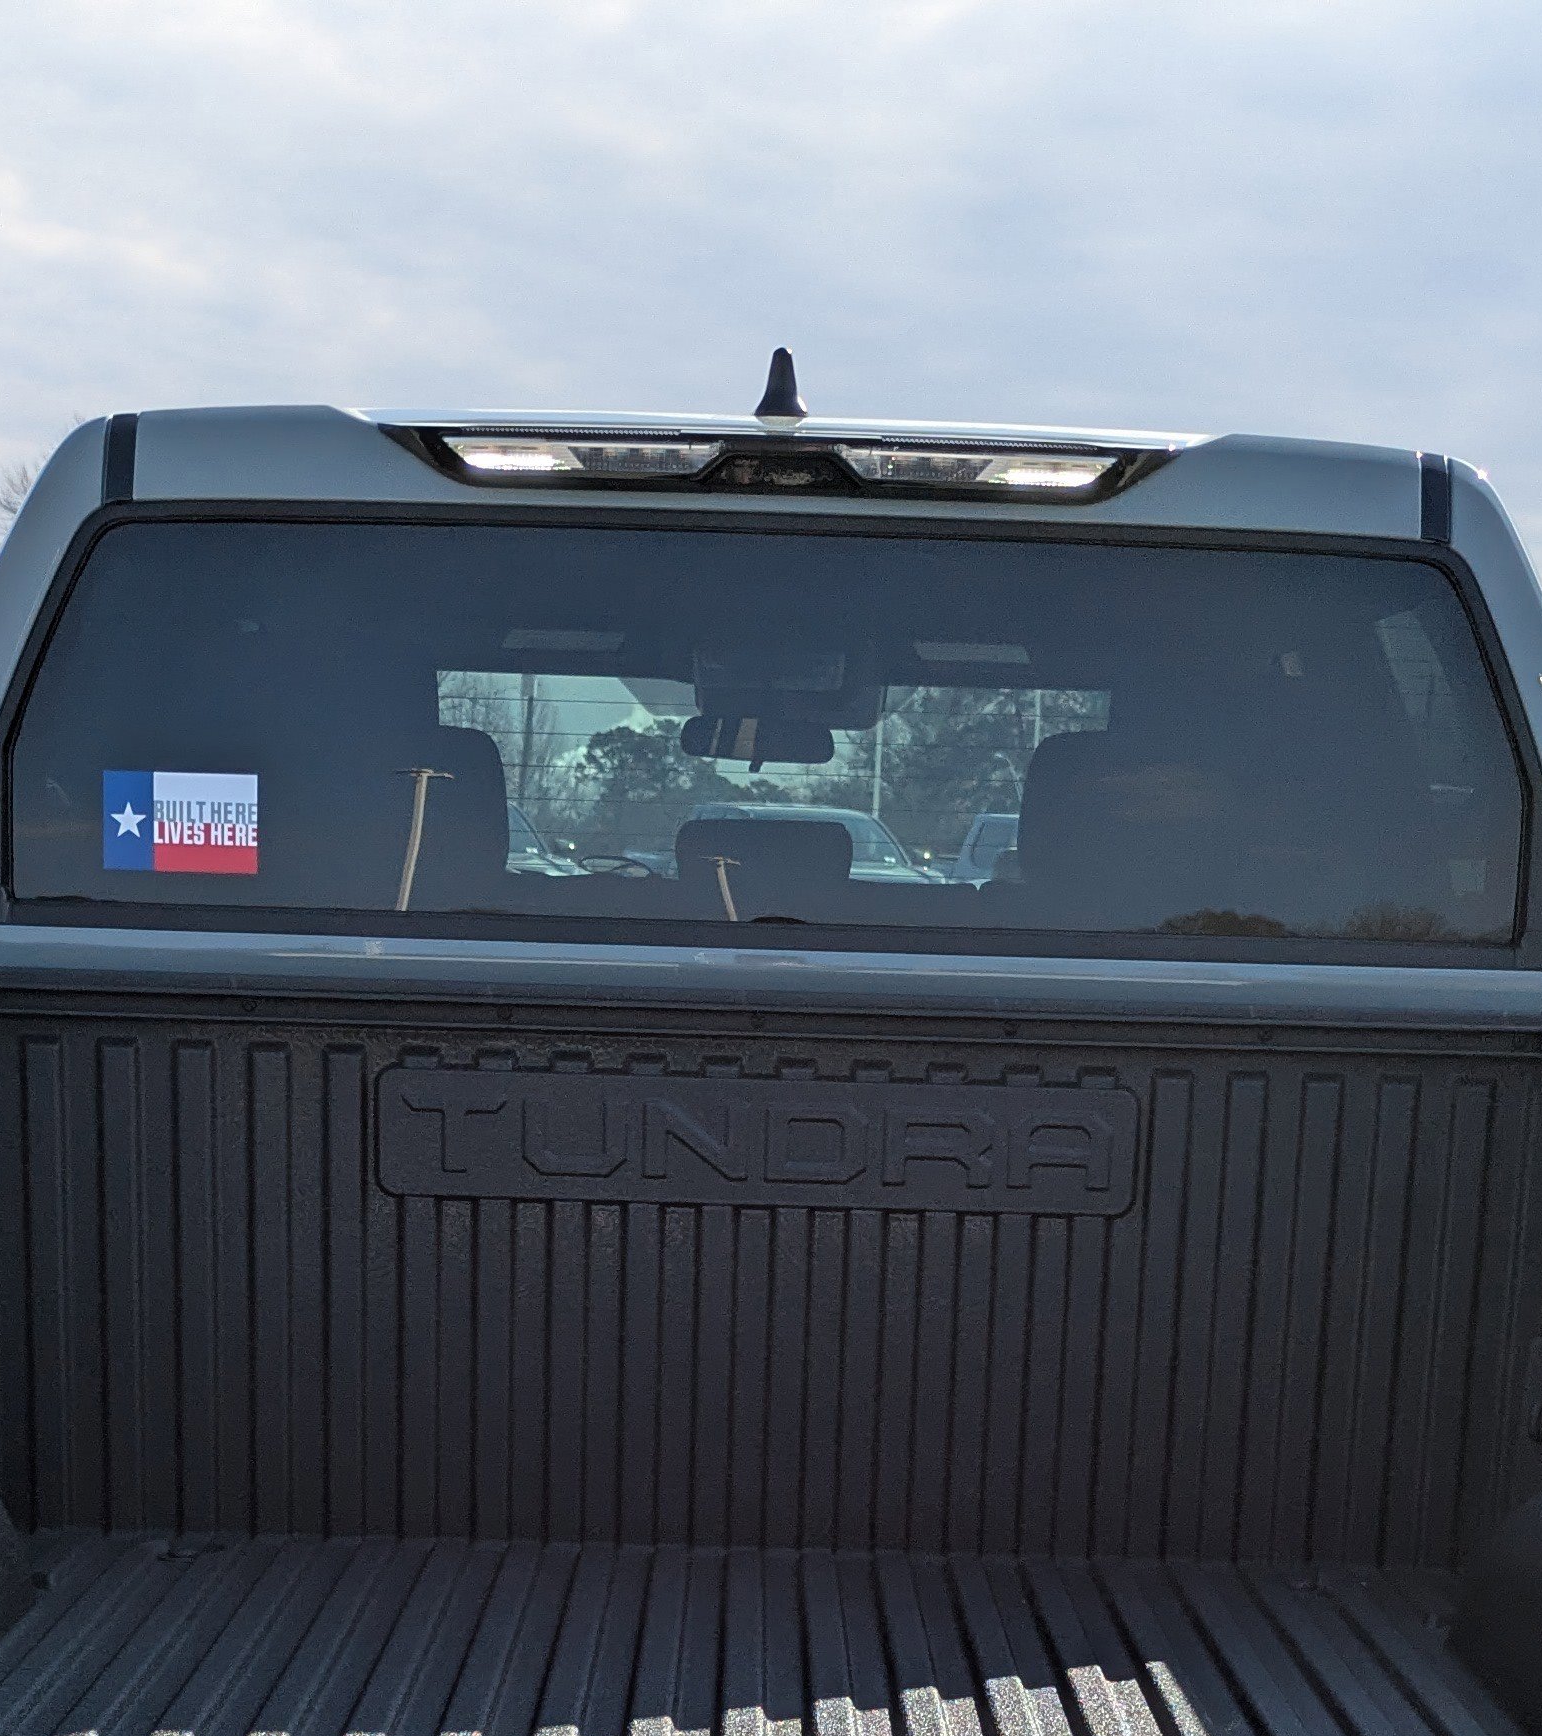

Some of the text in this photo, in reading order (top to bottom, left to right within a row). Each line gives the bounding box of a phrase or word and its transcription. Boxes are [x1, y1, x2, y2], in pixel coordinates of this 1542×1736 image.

[154, 800, 258, 825] BUILT HERE
[154, 821, 258, 847] LIVES HERE
[400, 1092, 1115, 1192] TUNDRA
